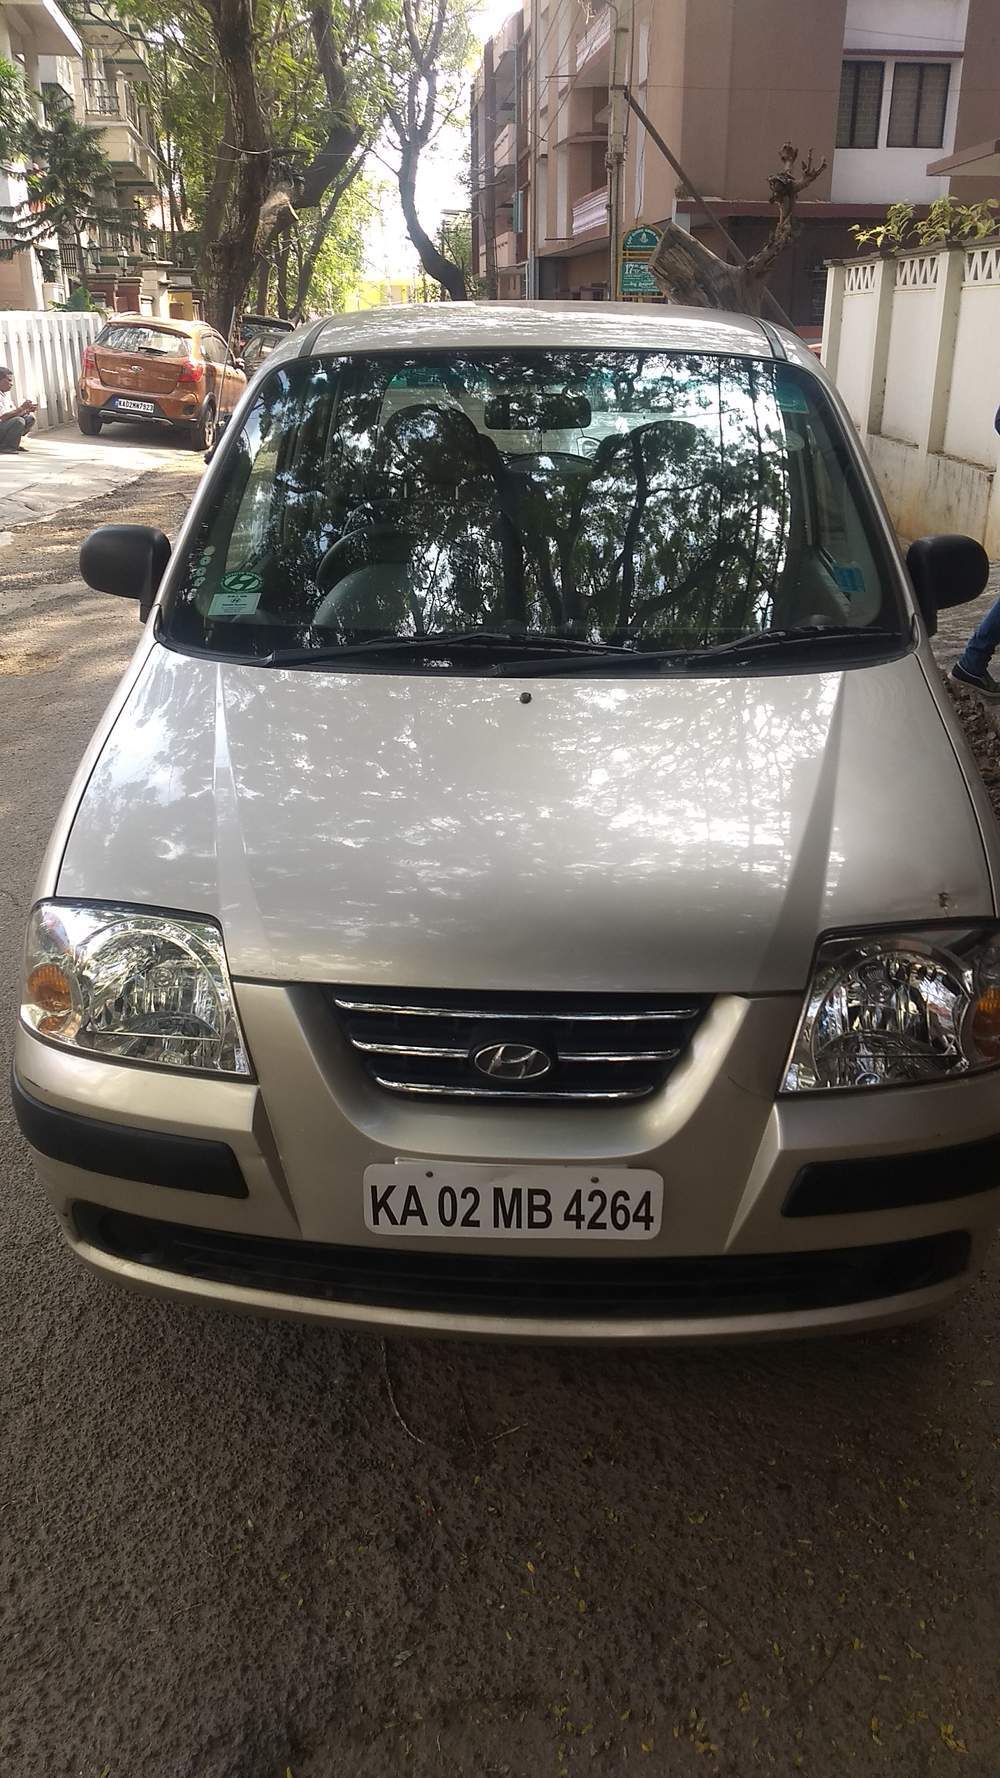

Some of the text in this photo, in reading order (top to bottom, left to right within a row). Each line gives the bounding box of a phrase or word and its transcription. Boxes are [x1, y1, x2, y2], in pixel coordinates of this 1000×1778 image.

[370, 1185, 654, 1231] KA 02 MB 4264
